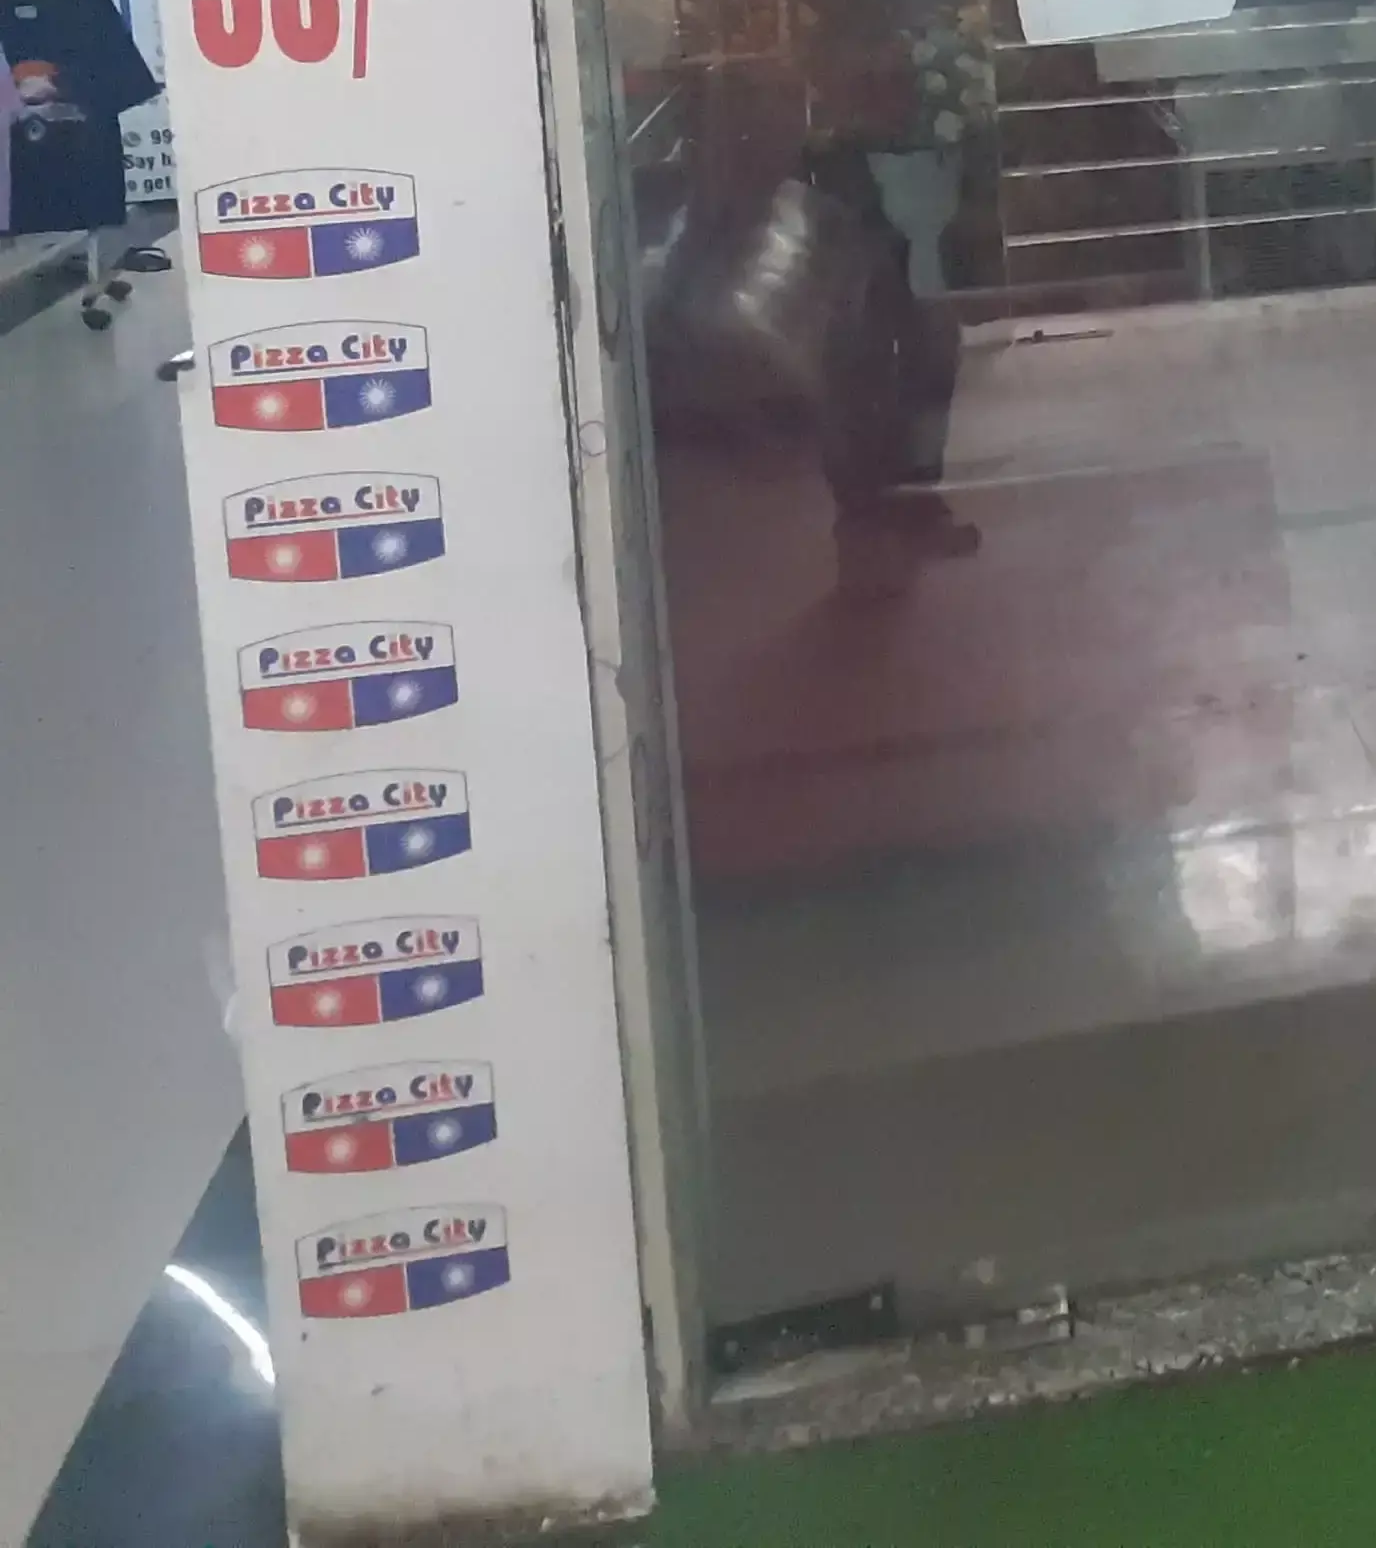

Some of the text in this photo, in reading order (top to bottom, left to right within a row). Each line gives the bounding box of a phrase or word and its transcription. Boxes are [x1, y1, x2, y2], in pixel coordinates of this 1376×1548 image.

[217, 182, 395, 217] Pizza City
[231, 334, 408, 370] Pizza City
[244, 485, 420, 522] Pizza City
[259, 633, 433, 673] Pizza City
[273, 782, 447, 822] Pizza City
[287, 929, 460, 969] Pizza City
